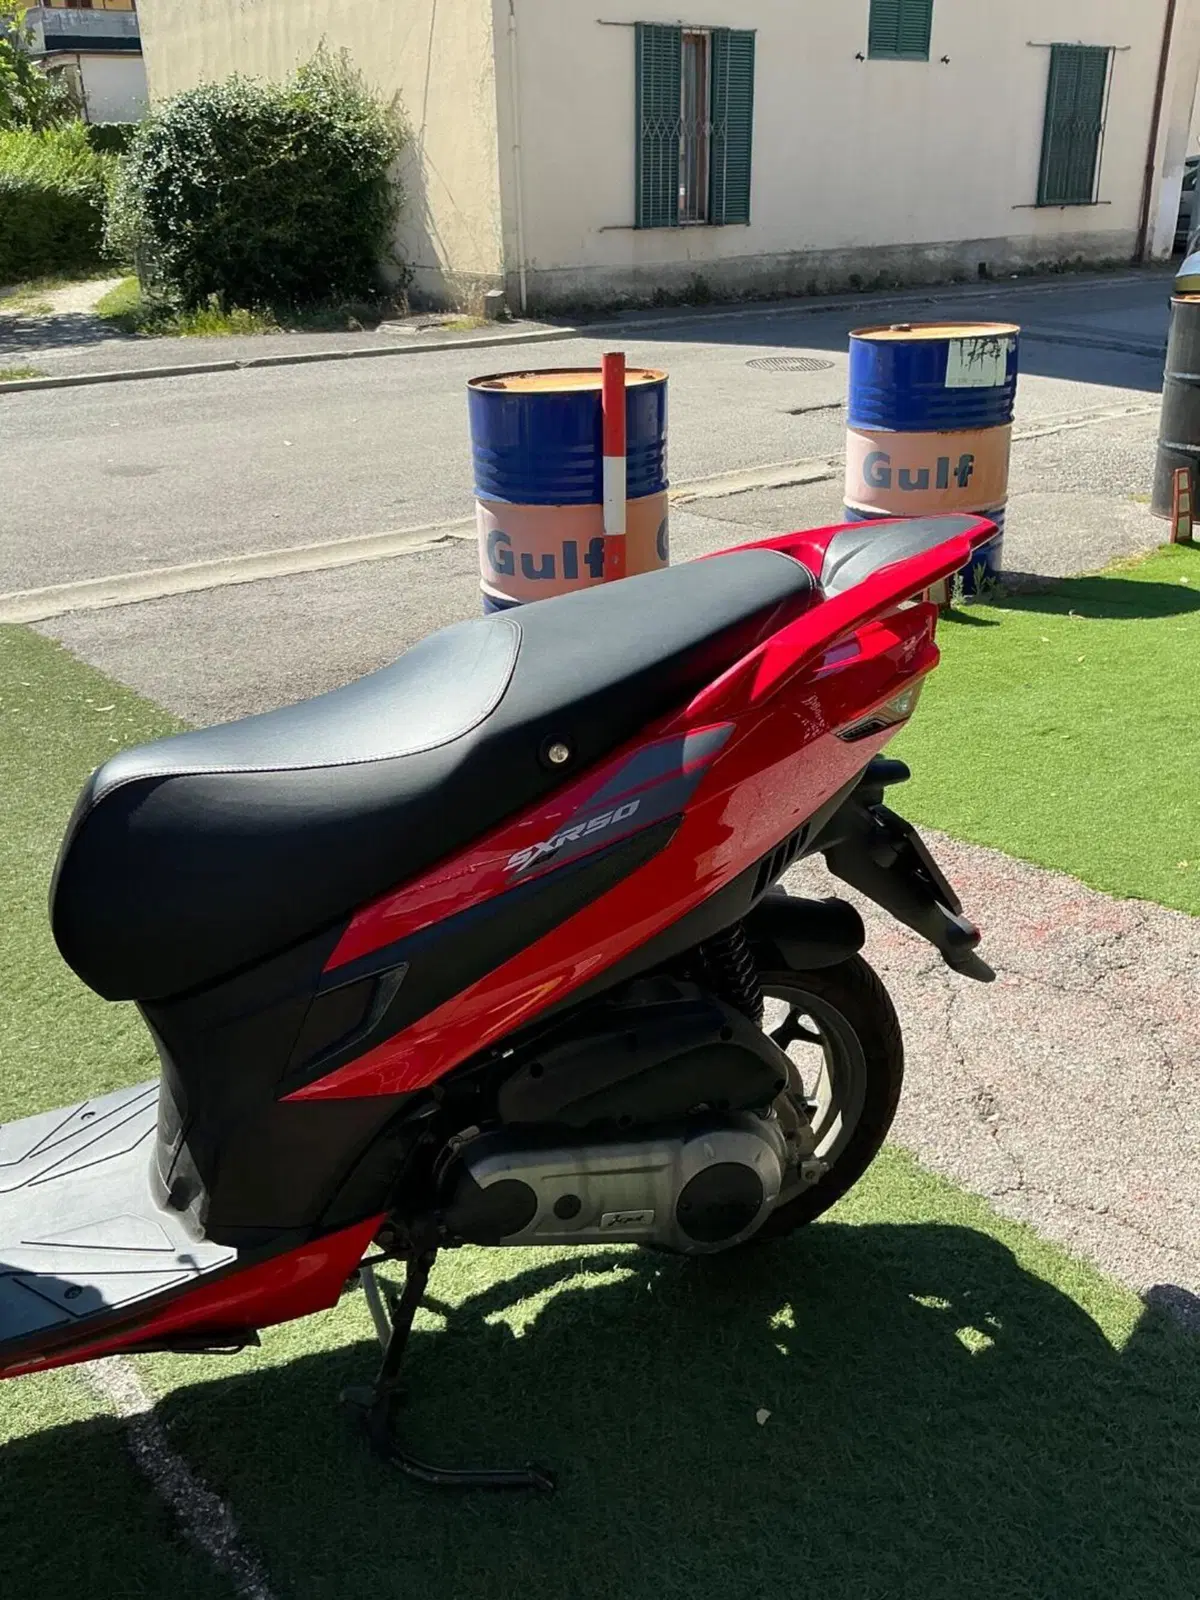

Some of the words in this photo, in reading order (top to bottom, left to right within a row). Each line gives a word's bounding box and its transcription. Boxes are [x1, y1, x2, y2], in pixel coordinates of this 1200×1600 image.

[863, 451, 975, 491] Gulf
[487, 528, 605, 580] Gulf
[502, 799, 640, 873] SXR50
